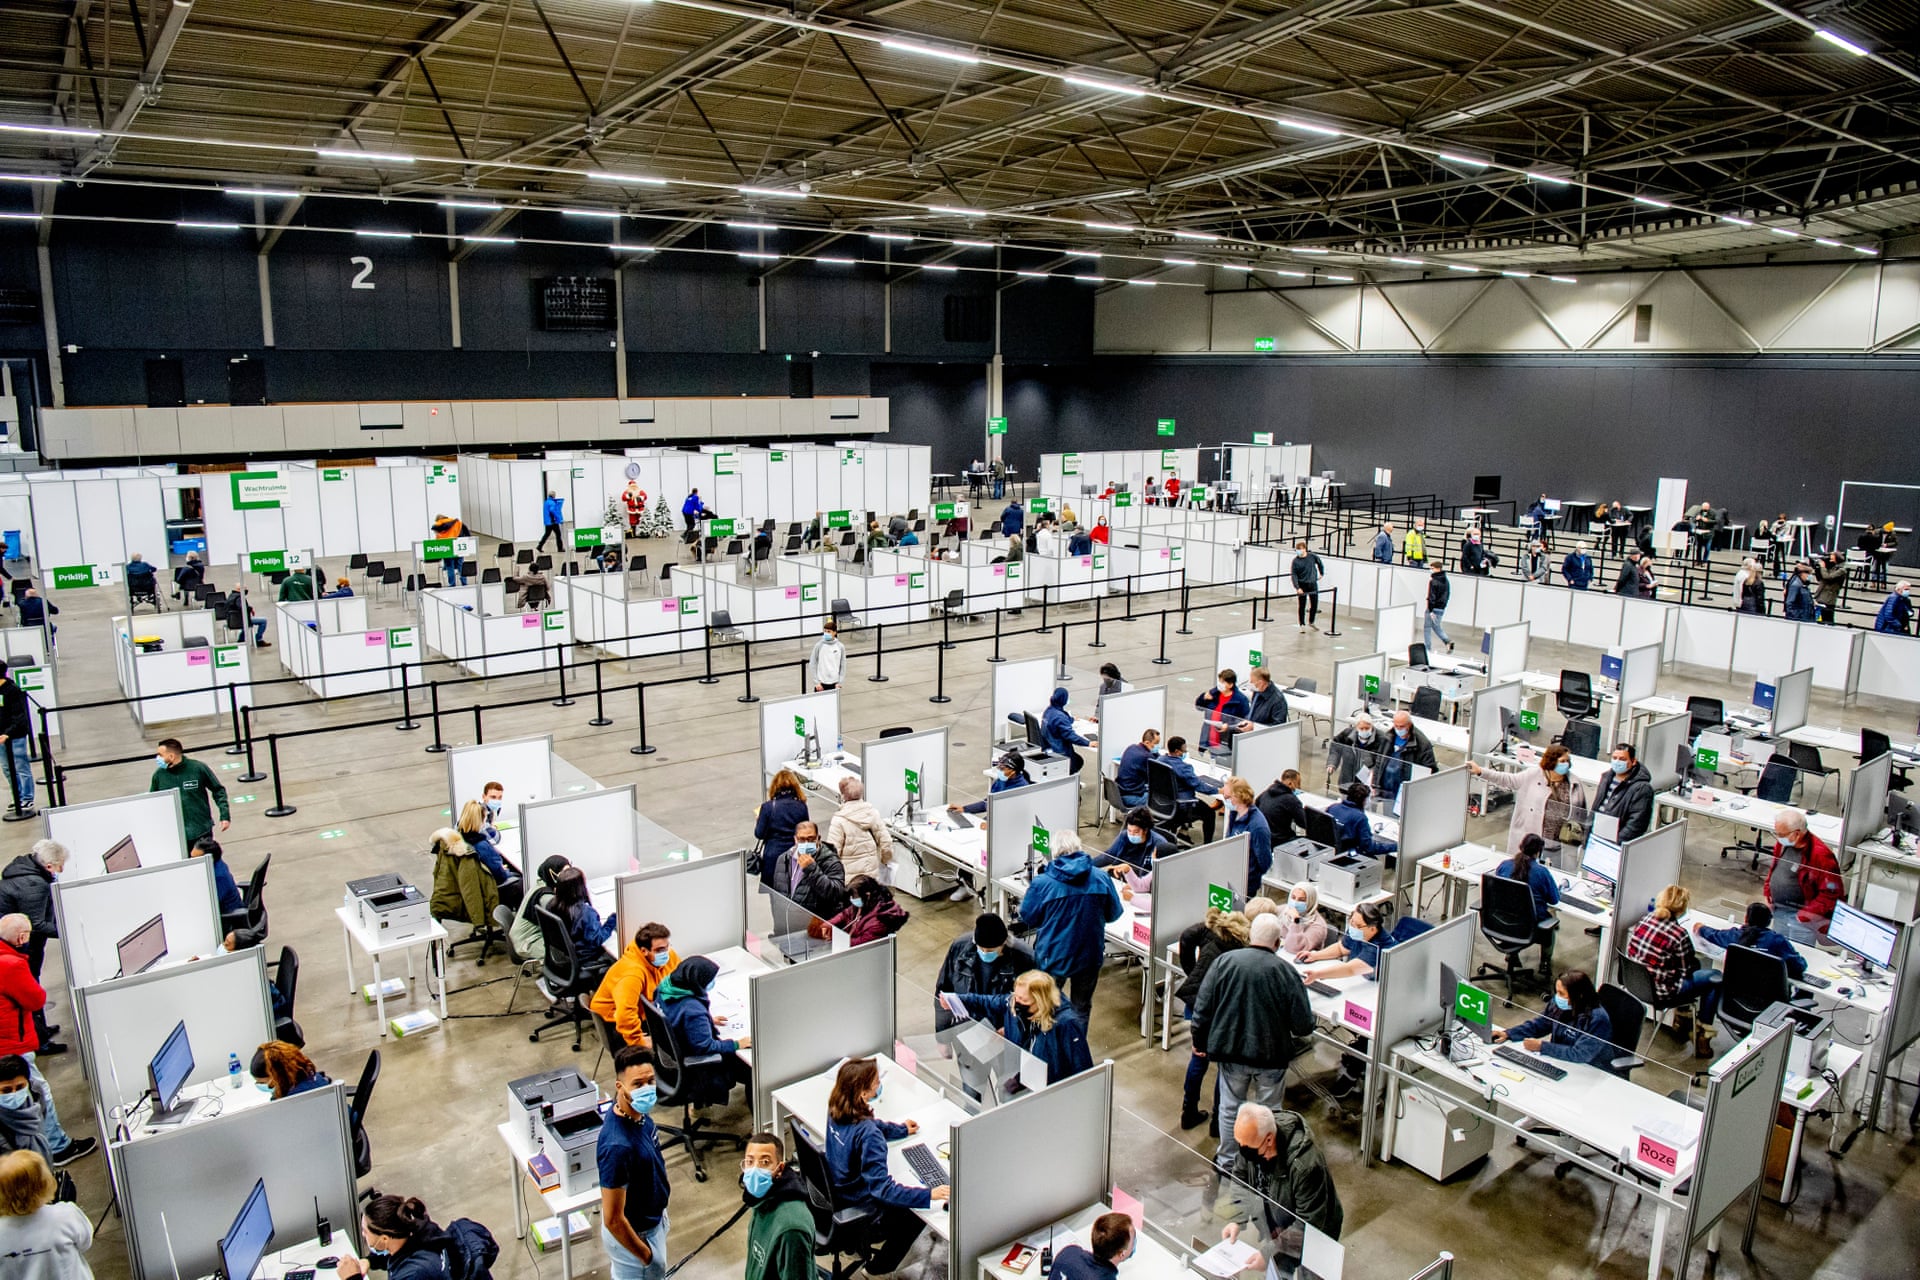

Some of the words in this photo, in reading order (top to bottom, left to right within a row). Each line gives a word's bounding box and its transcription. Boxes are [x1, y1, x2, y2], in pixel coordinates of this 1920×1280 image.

[350, 256, 376, 289] 2
[244, 484, 287, 492] Wachtruimte
[713, 523, 731, 532] Priklijn
[577, 532, 598, 541] Priklijn
[427, 545, 450, 554] Priklijn
[457, 543, 467, 551] 13
[254, 555, 281, 566] Priklijn
[289, 555, 300, 564] 12
[58, 571, 88, 582] Priklijn
[98, 571, 110, 579] 11
[1250, 654, 1261, 663] E-5
[1365, 680, 1378, 689] E-4
[1521, 715, 1537, 726] E-3
[1698, 753, 1717, 766] E-2
[905, 775, 919, 788] C-4
[1033, 832, 1049, 848] C-3
[1210, 892, 1231, 910] C-2
[1133, 926, 1150, 941] Roz
[1459, 994, 1486, 1016] C-1
[1349, 1008, 1368, 1023] Roze
[1640, 1142, 1675, 1167] Roze
